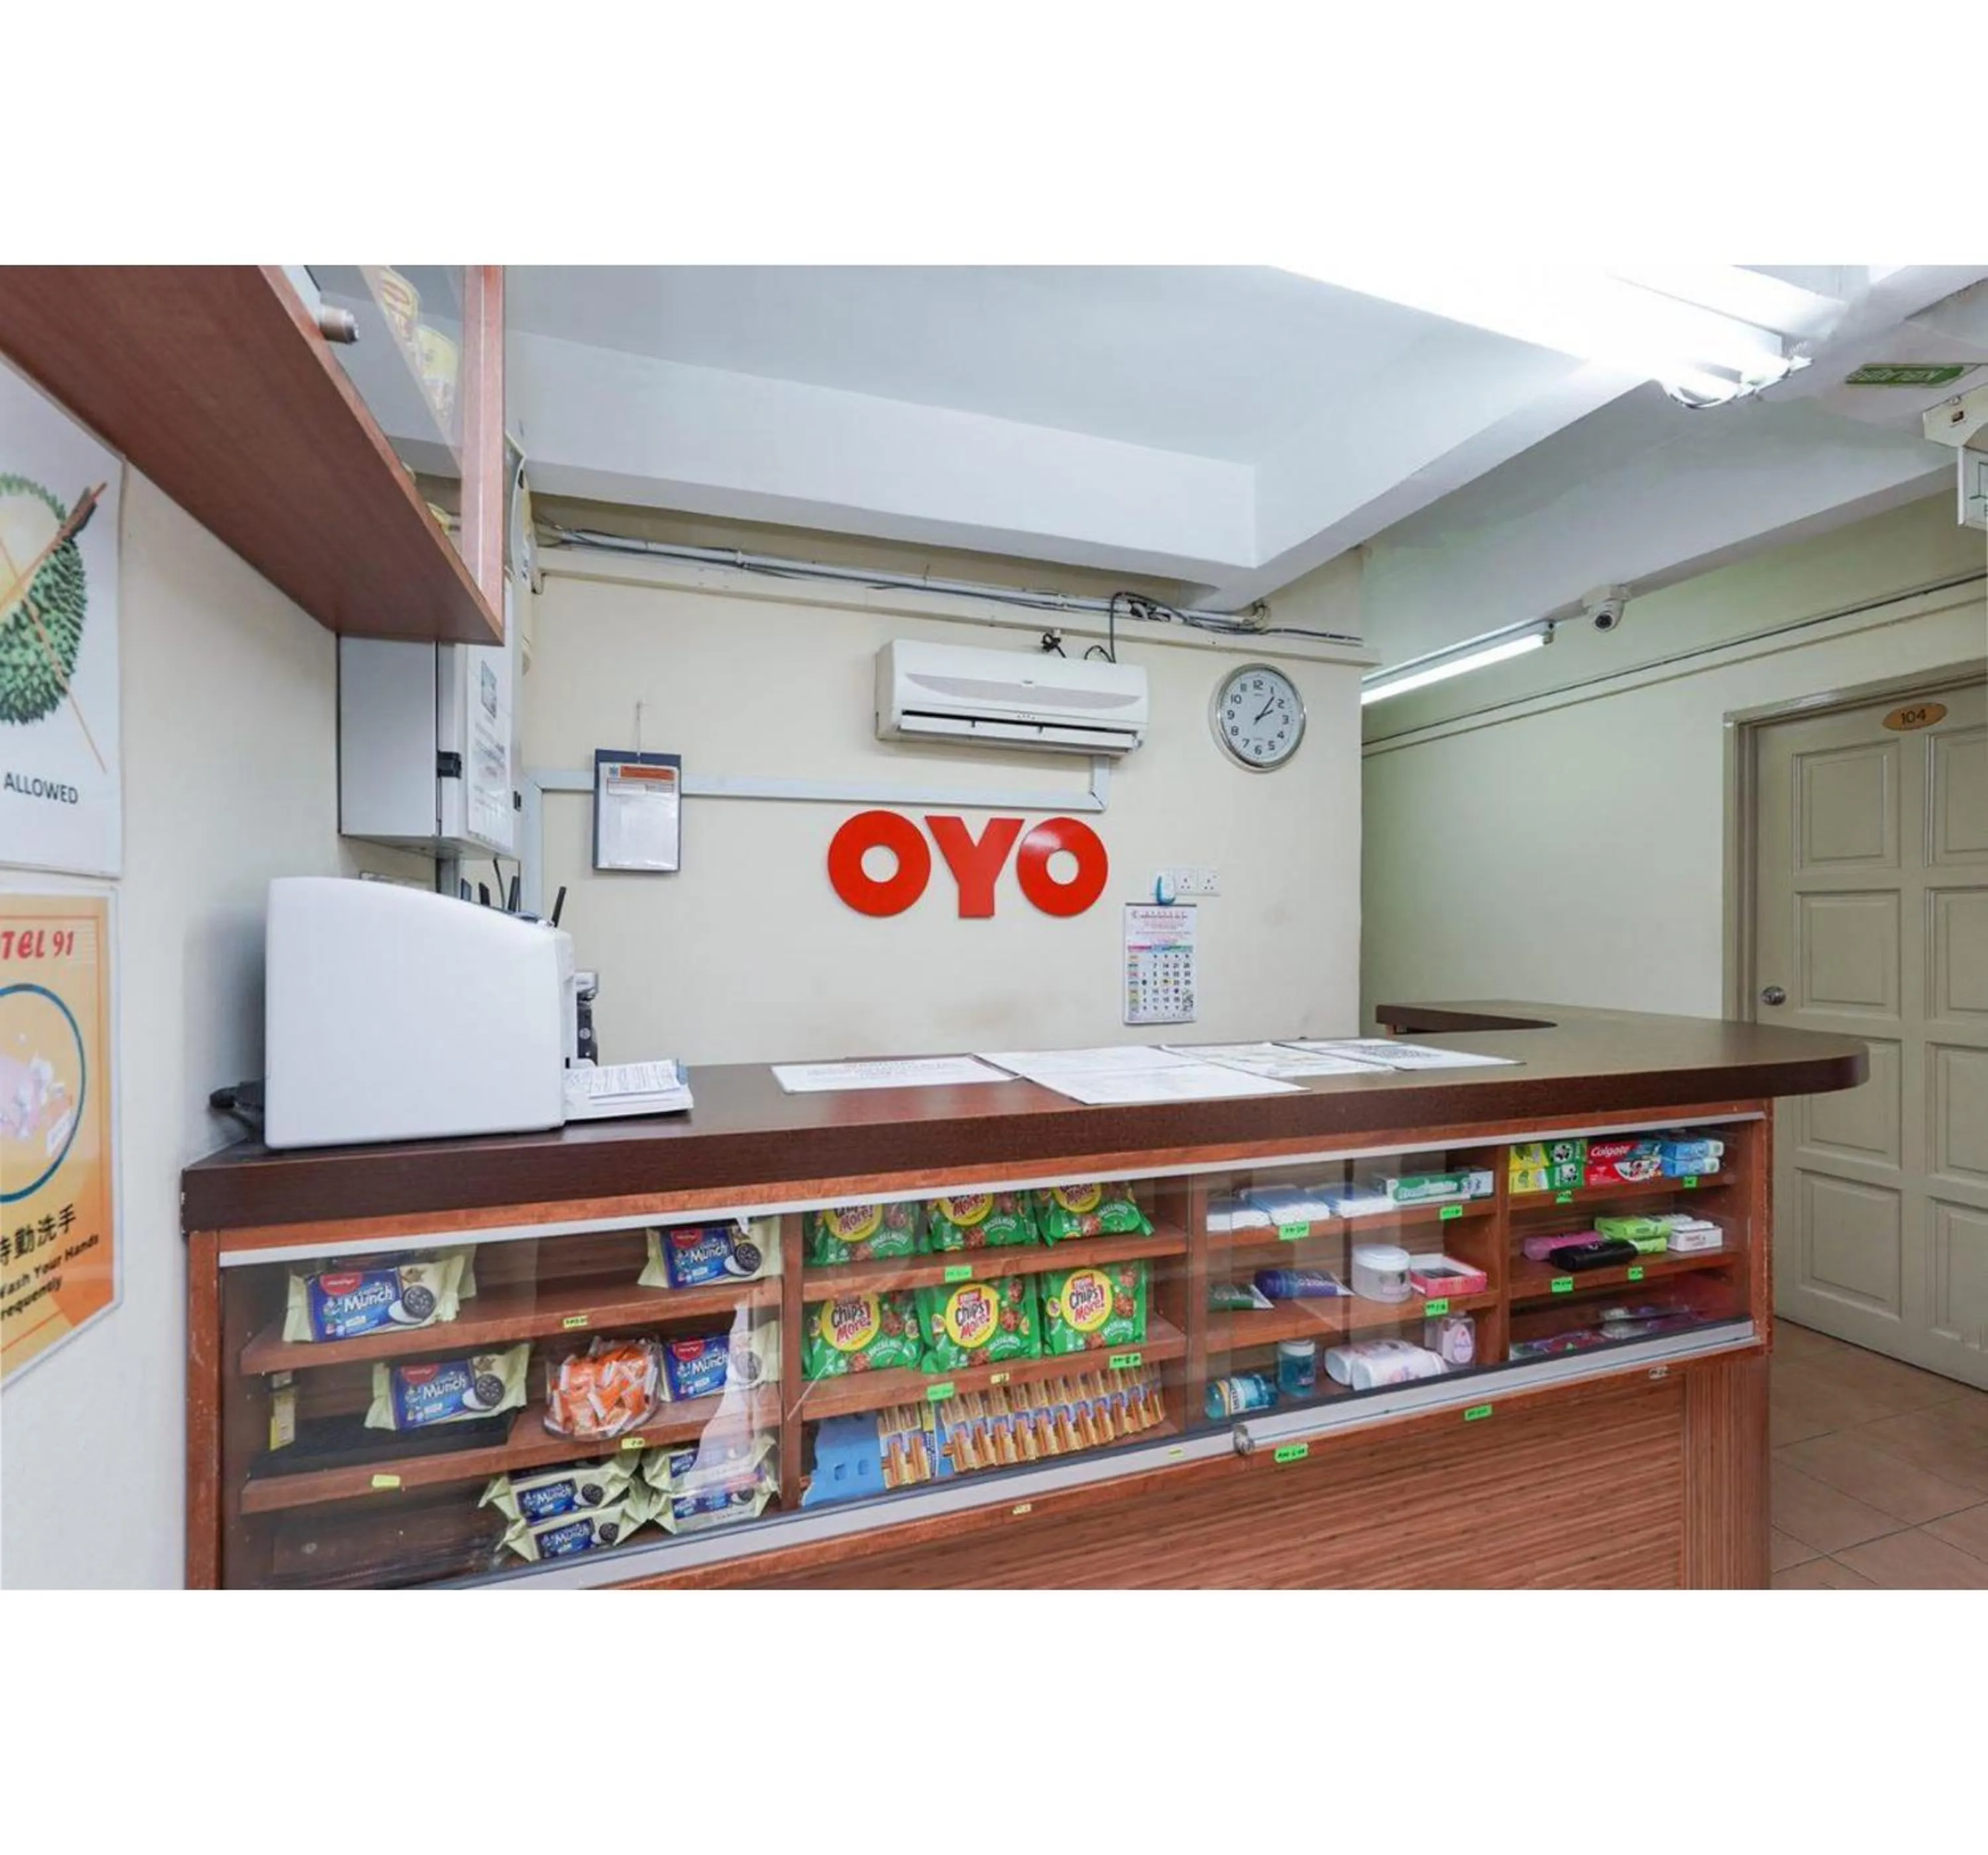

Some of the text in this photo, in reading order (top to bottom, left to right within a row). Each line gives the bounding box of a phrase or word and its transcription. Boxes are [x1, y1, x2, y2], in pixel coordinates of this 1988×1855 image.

[1231, 694, 1242, 705] 10
[1277, 699, 1285, 710] 2
[1227, 710, 1235, 720] 9
[1282, 715, 1290, 725] 3
[1901, 709, 1926, 725] 104
[1277, 731, 1285, 739] 4
[1242, 738, 1250, 748] 7
[1268, 740, 1276, 751] 5
[1254, 745, 1262, 755] 6
[3, 771, 79, 805] ALLOWED
[827, 810, 1109, 919] OYO
[52, 929, 74, 957] 91
[343, 1283, 394, 1313] Munch
[423, 1375, 468, 1401] Munch
